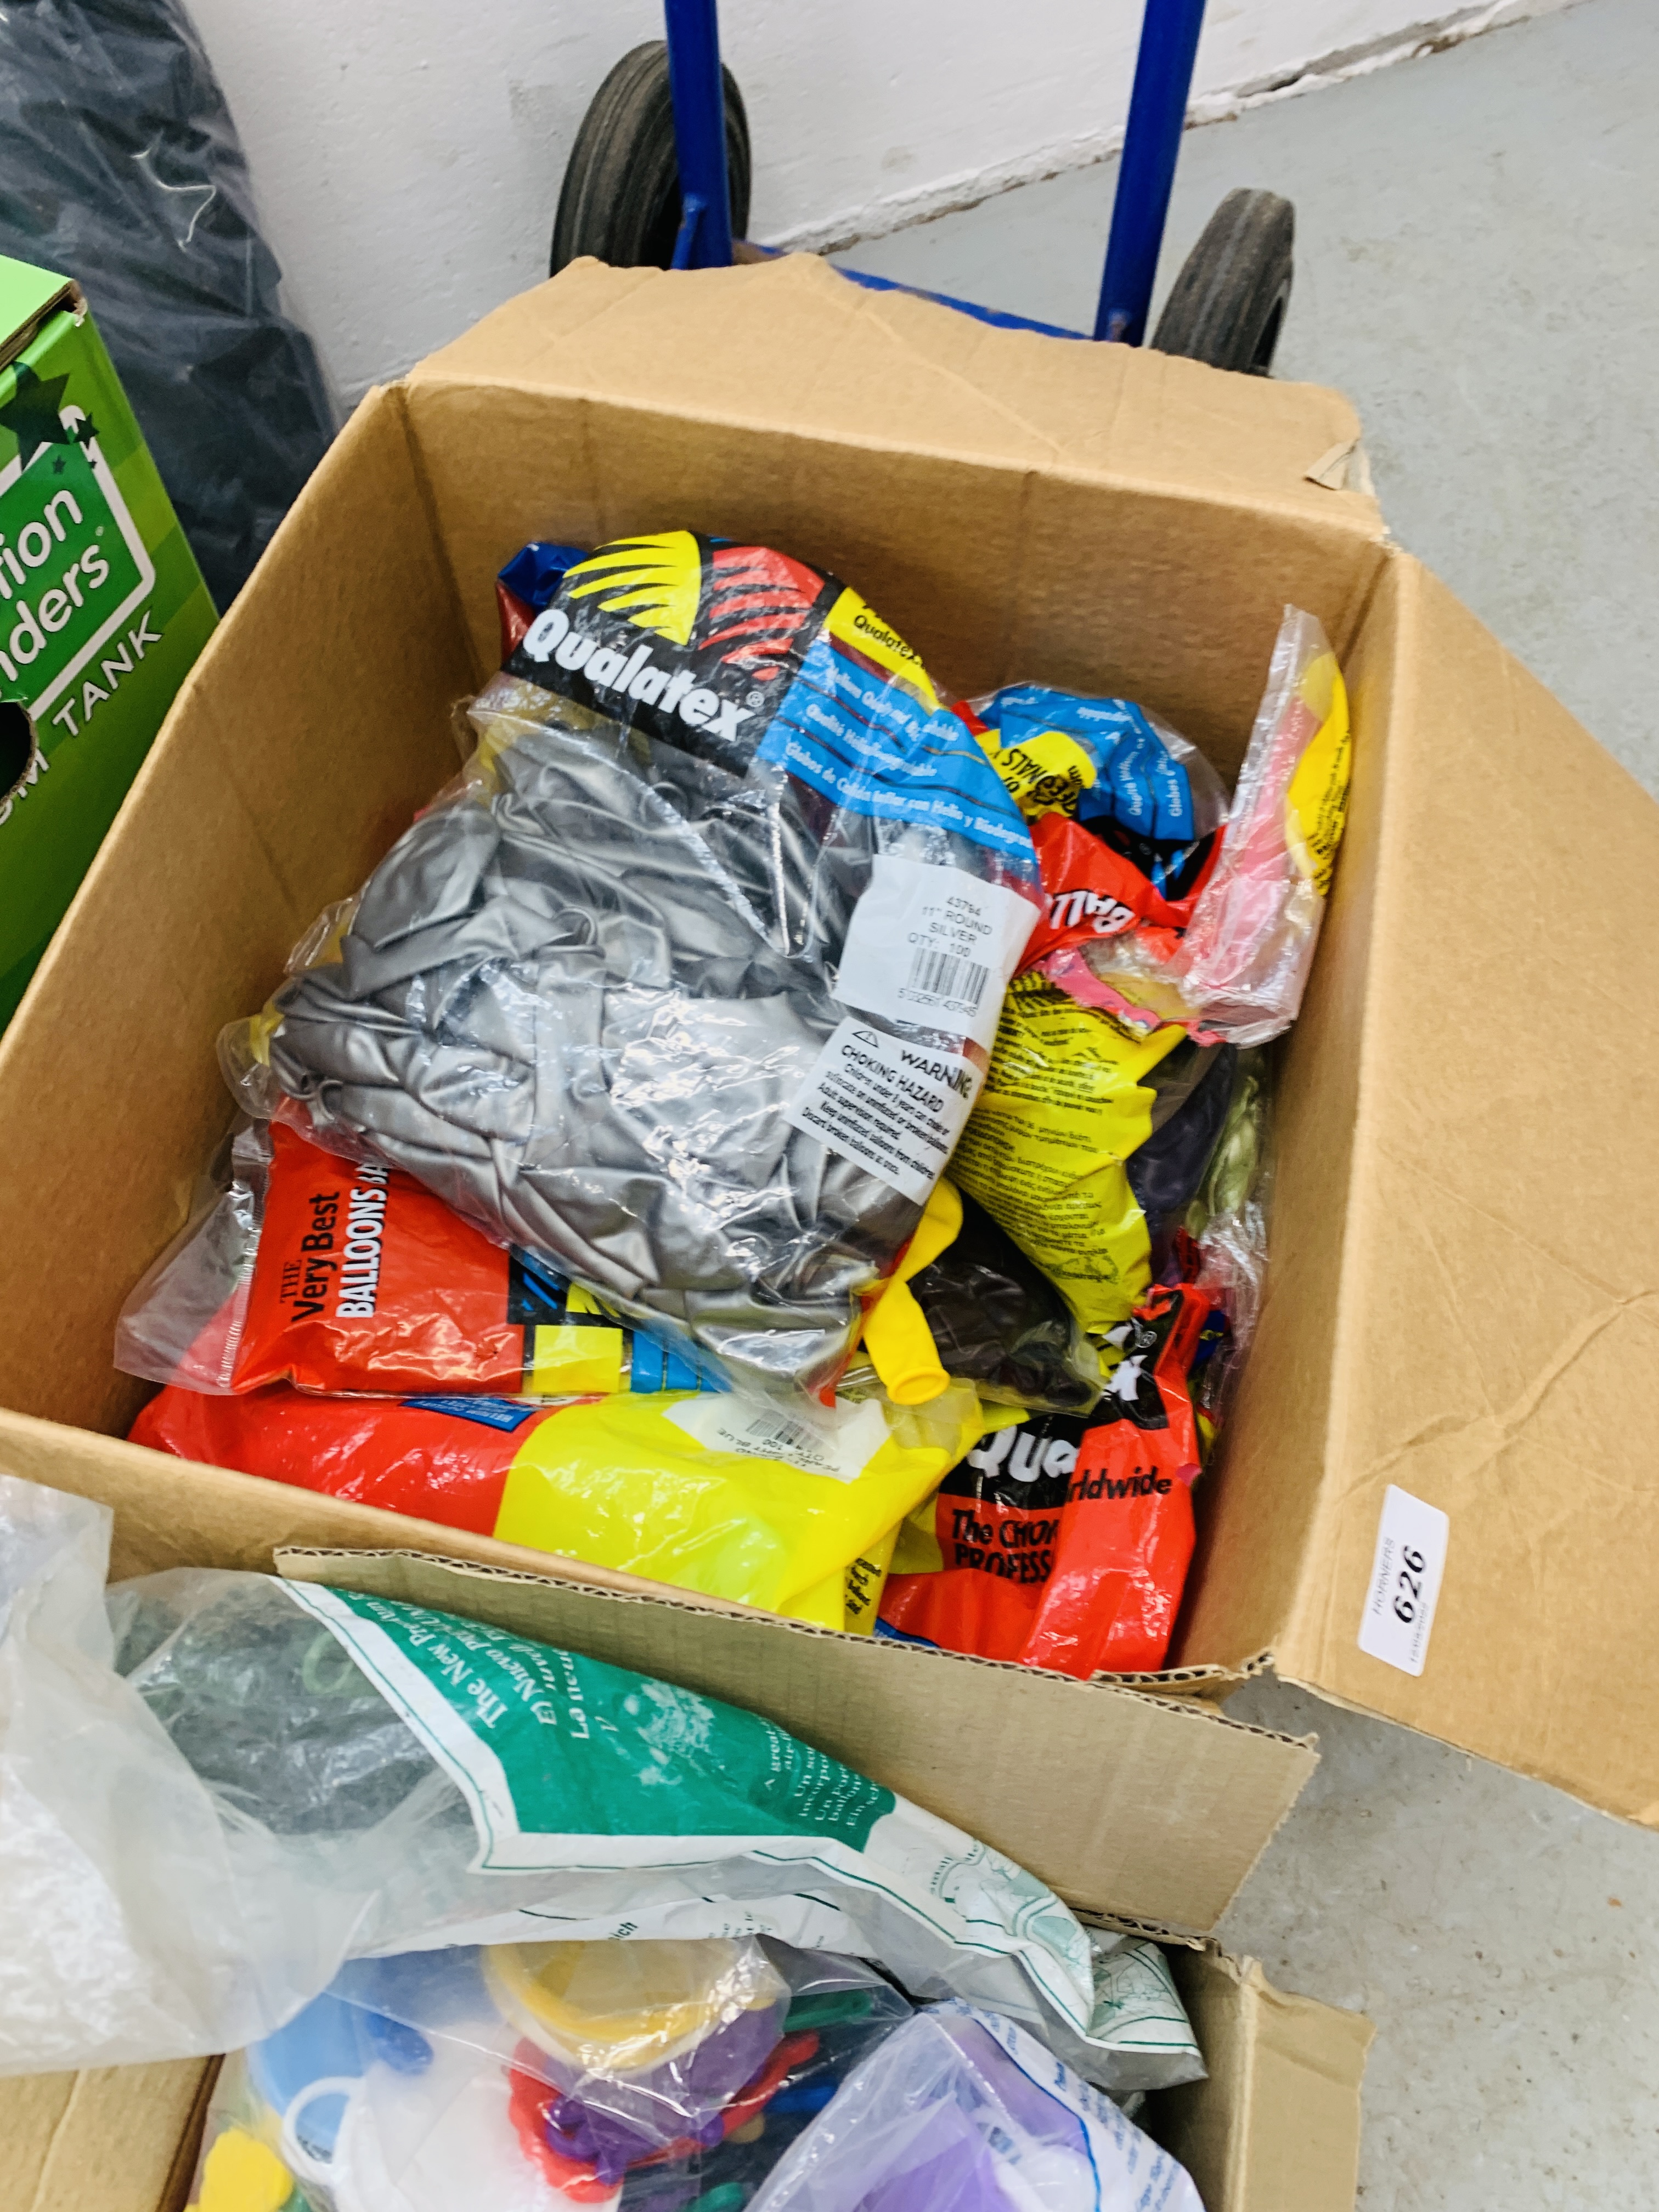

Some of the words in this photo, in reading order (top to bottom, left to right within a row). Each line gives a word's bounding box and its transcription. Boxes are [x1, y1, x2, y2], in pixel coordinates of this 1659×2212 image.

[52, 612, 164, 737] TANK
[523, 608, 755, 742] Qualatex
[929, 922, 978, 946] SILVER
[944, 910, 993, 935] ROUND
[949, 943, 972, 958] 100
[839, 1043, 897, 1084] CHOKING
[894, 1074, 946, 1114] HAZARD
[302, 1191, 340, 1253] Best
[336, 1187, 388, 1318] BALLOONS
[280, 1260, 302, 1305] THE
[291, 1257, 340, 1323] Very
[716, 1426, 751, 1448] BLUE
[1069, 1466, 1173, 1504] rldwide
[952, 1509, 993, 1547] The
[1371, 1537, 1396, 1616] HORNERS
[1392, 1544, 1427, 1624] 626
[433, 1647, 477, 1686] New
[466, 1678, 510, 1729] The
